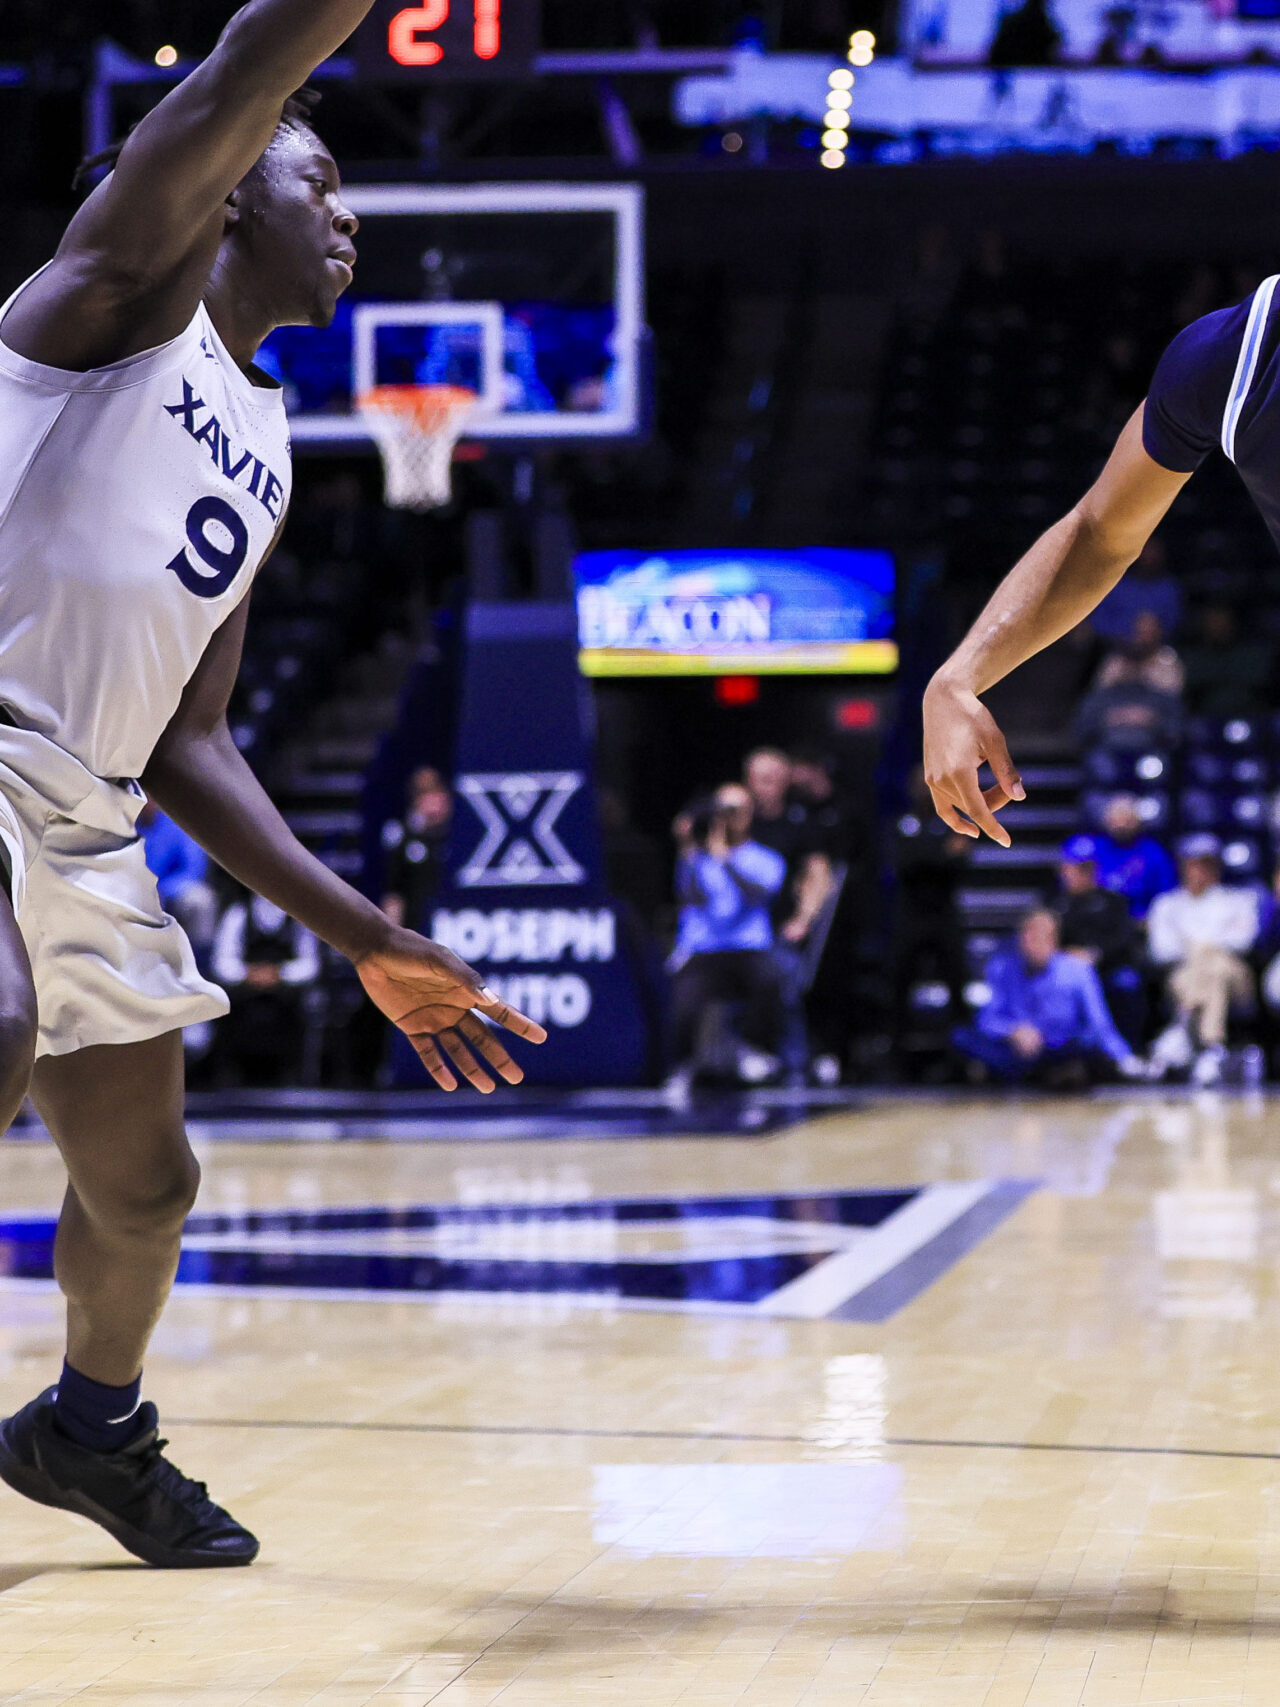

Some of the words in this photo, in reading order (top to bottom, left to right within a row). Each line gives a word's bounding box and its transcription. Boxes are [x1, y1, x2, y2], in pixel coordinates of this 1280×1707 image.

[387, 0, 500, 66] 21
[163, 374, 286, 532] XAVIE
[166, 495, 249, 599] 9
[470, 972, 593, 1029] UTO
